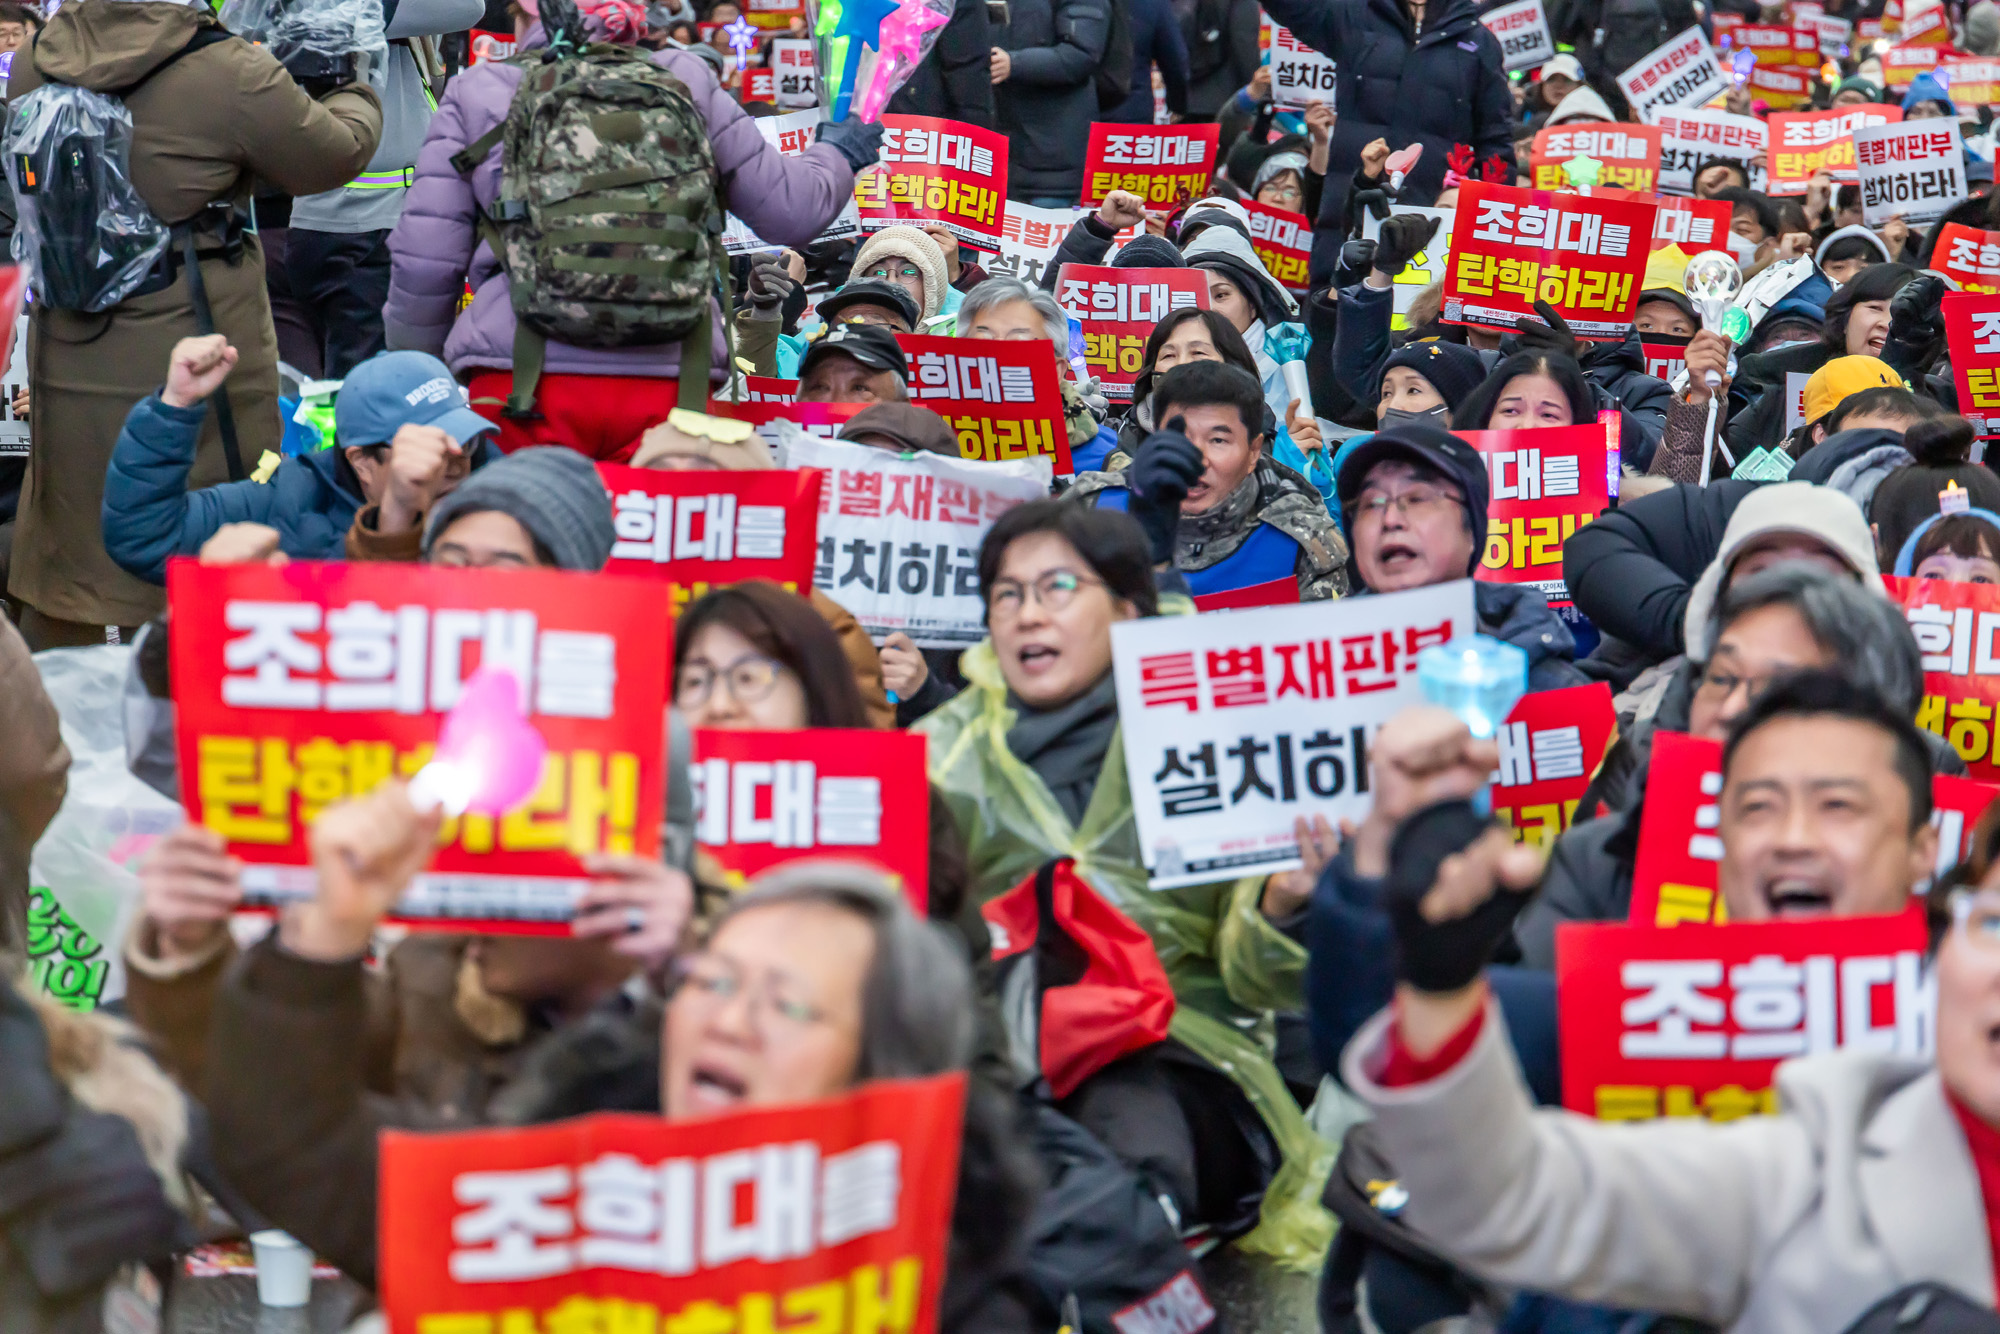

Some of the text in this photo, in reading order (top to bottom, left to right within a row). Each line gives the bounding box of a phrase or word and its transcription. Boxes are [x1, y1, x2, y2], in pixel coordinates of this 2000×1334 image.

[879, 128, 993, 177] 조희대를
[1103, 135, 1206, 165] 조희대를
[1545, 131, 1648, 159] 조희대를
[1859, 131, 1952, 166] 특별재판부
[855, 173, 998, 226] 탄핵하라!
[1864, 168, 1957, 207] 설치하라!
[1246, 209, 1314, 252] 희대를
[1473, 199, 1631, 257] 조희대를
[1652, 208, 1715, 243] 대를
[1456, 252, 1634, 313] 탄핵하라!
[943, 415, 1057, 464] 하라!
[1480, 448, 1580, 500] 대를
[607, 490, 786, 563] 희대를
[221, 600, 616, 719] 조희대를
[1620, 949, 1939, 1060] 조희대
[448, 1139, 901, 1284] 조희대를
